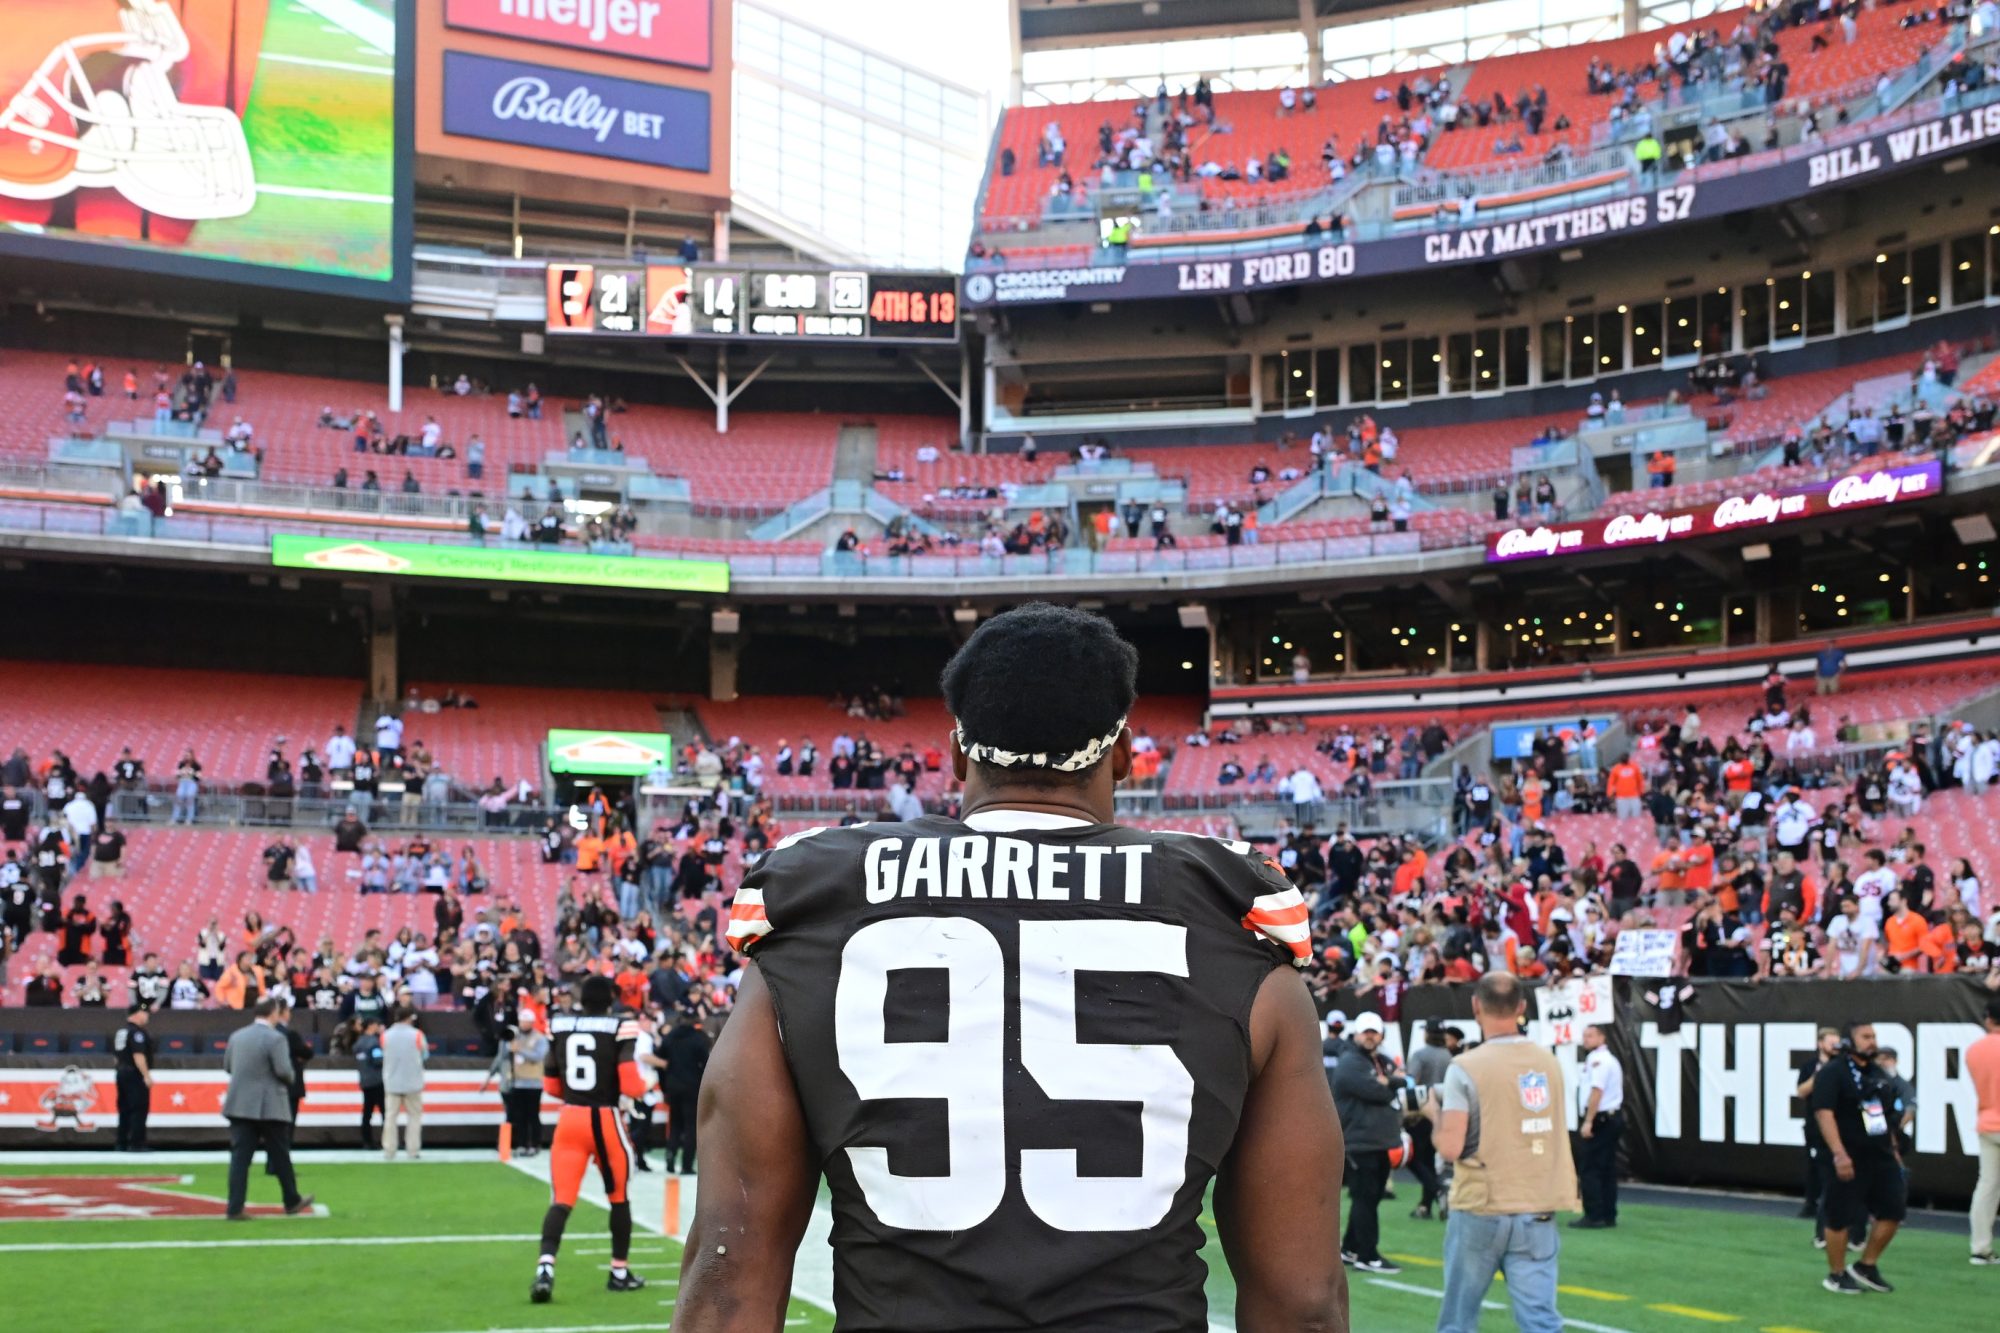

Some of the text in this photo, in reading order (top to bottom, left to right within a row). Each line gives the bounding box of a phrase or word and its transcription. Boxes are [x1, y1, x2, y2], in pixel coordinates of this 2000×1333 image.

[492, 76, 666, 142] Bally BET
[1808, 103, 2000, 189] BILL WILLIS
[1424, 185, 1695, 264] CLAY MATTHEWS 57
[995, 267, 1126, 289] CROSSCOUNTRY
[1178, 245, 1355, 291] LEN FORD 80
[600, 274, 628, 313] 21
[703, 277, 735, 316] 14
[870, 290, 954, 323] 4TH & 13
[1828, 472, 1929, 507] Bally BET
[1603, 512, 1670, 544] Bally
[1713, 493, 1781, 527] Bally
[1496, 527, 1559, 557] Bally
[436, 553, 504, 572] Cleaning
[604, 563, 698, 582] Construction
[864, 835, 1152, 904] GARRETT
[565, 1033, 597, 1091] 6
[835, 916, 1195, 1231] 95
[1640, 1022, 1817, 1146] THE
[1521, 1116, 1552, 1134] MEDIA
